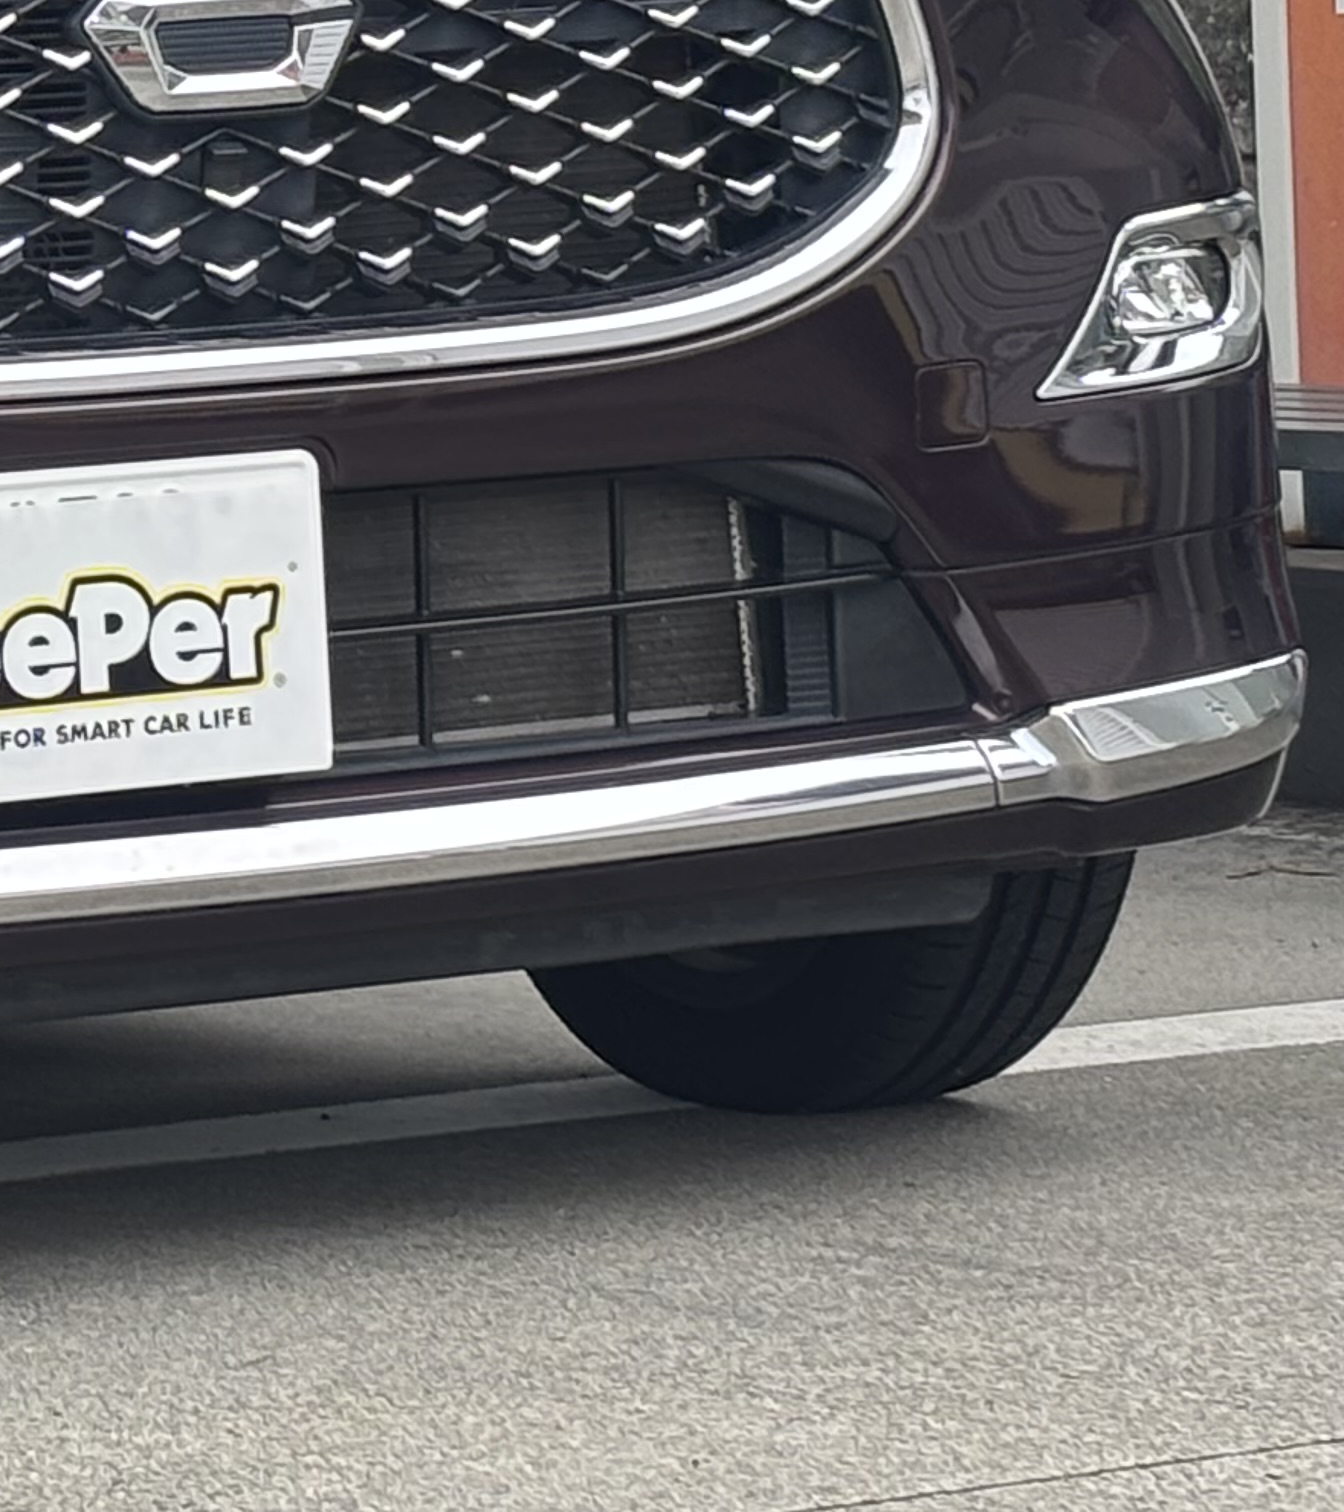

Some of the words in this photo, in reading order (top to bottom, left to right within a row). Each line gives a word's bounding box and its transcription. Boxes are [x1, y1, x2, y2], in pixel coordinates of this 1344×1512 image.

[0, 726, 47, 752] FOR
[56, 718, 135, 745] SMART
[144, 713, 190, 736] CAR
[199, 706, 253, 730] LIFE
